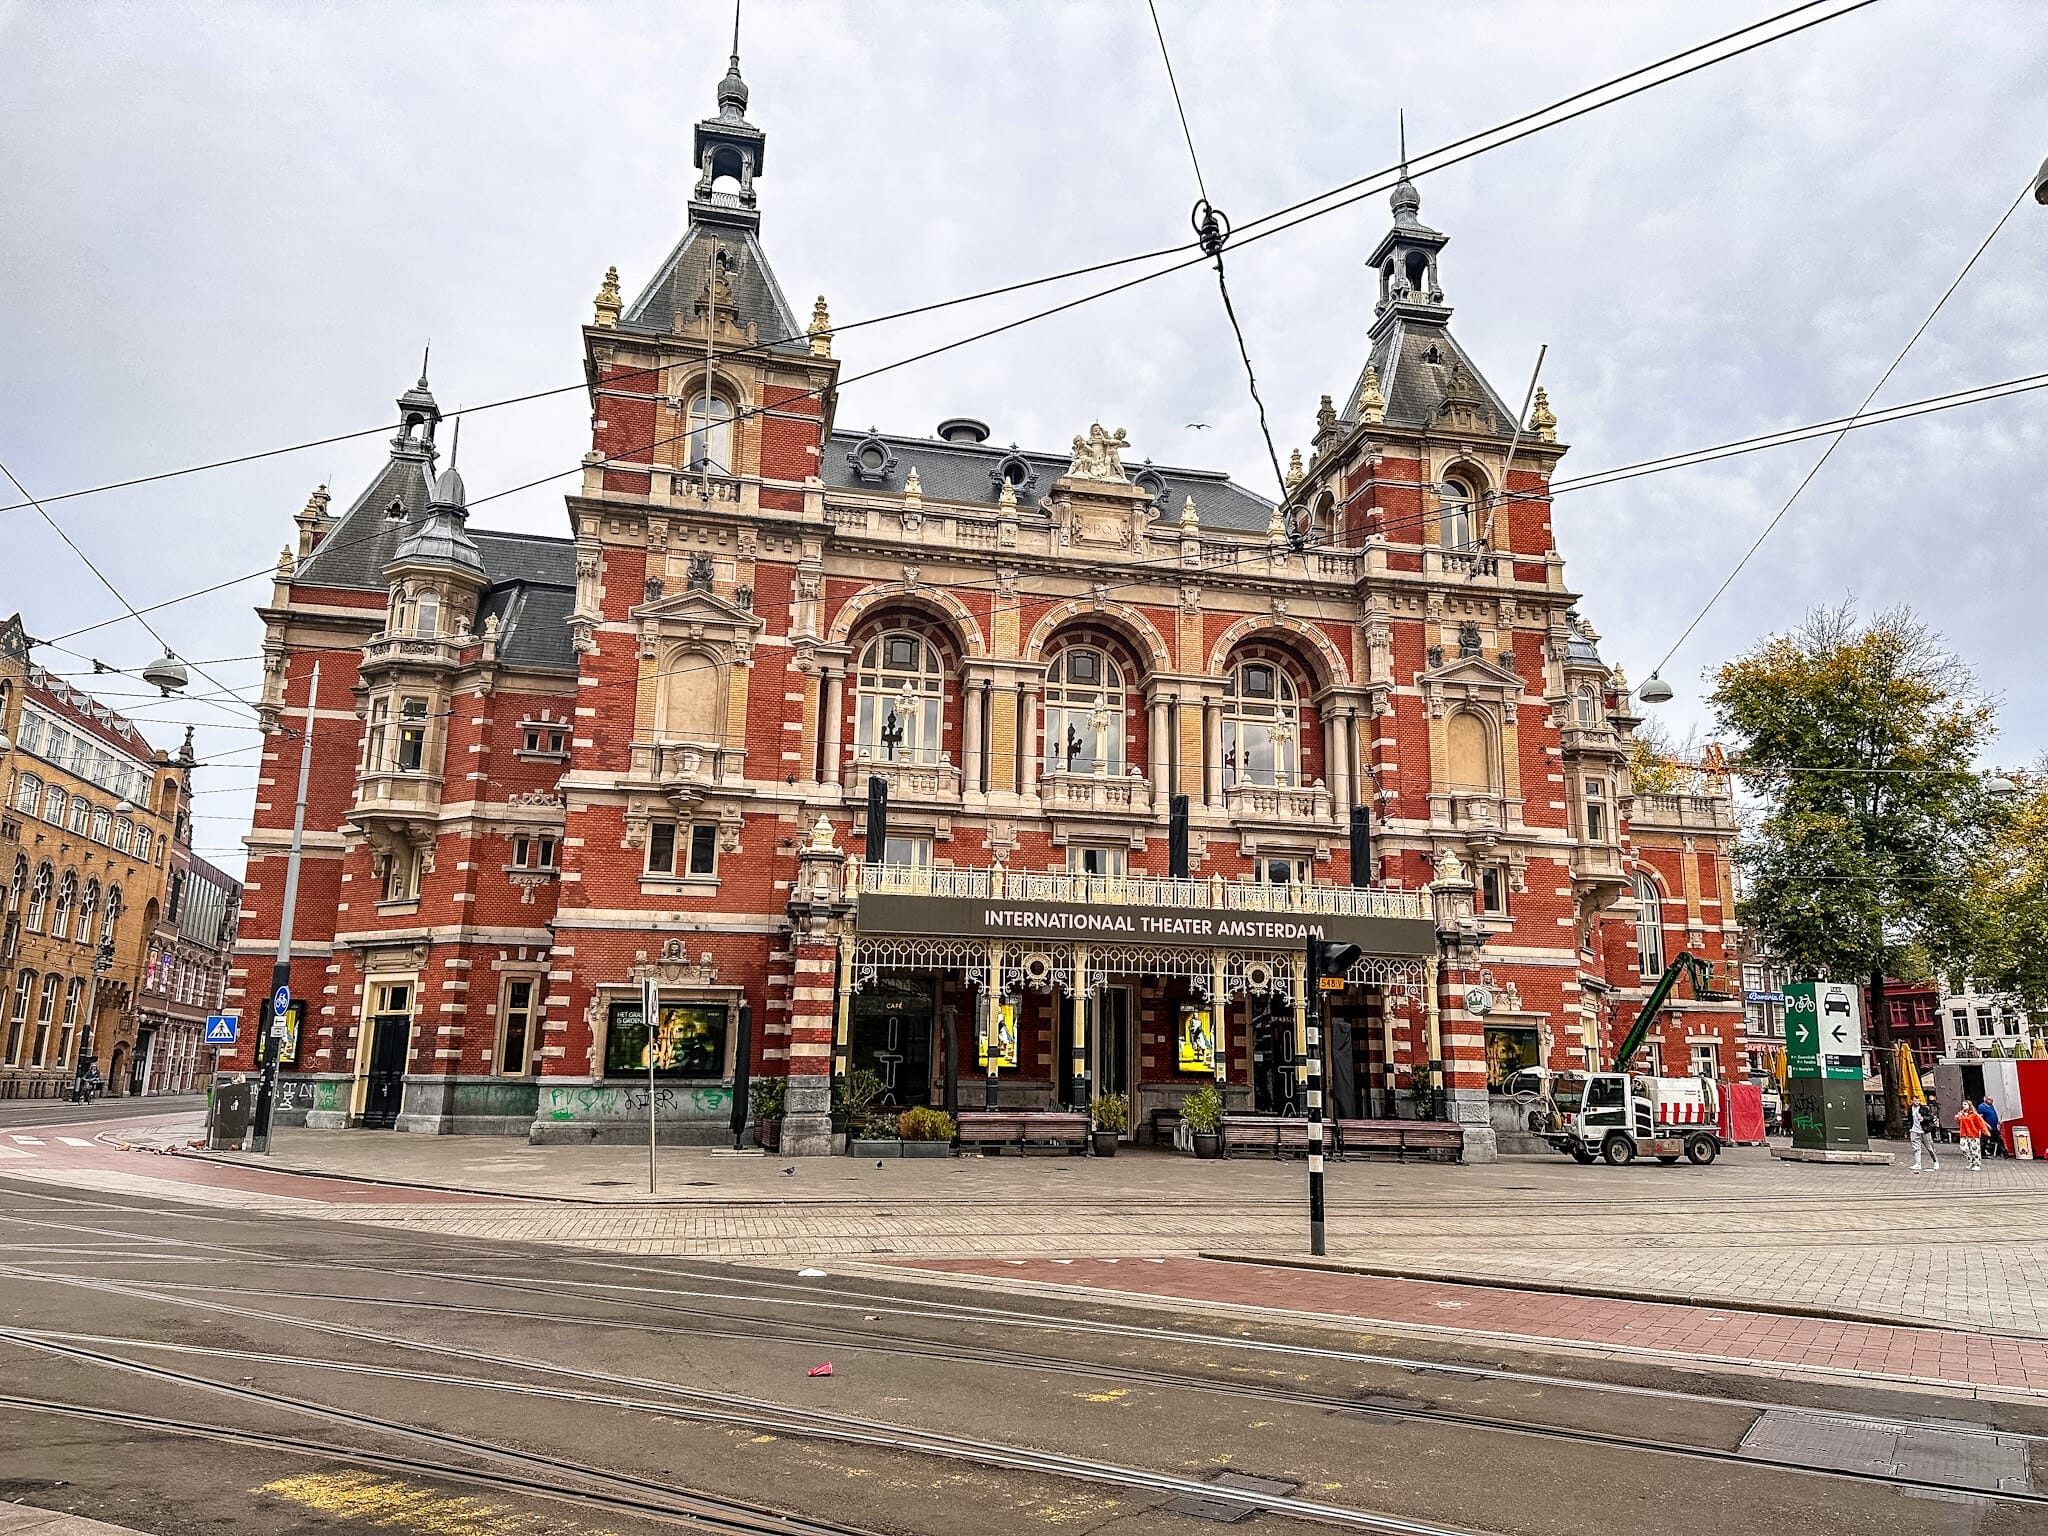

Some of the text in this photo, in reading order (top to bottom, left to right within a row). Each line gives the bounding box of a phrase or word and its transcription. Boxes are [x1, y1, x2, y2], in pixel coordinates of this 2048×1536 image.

[984, 910, 1325, 940] INTERNATIONAAL THEATER AMSTERDAM
[886, 1001, 904, 1010] CAFÉ
[1785, 995, 1795, 1014] P
